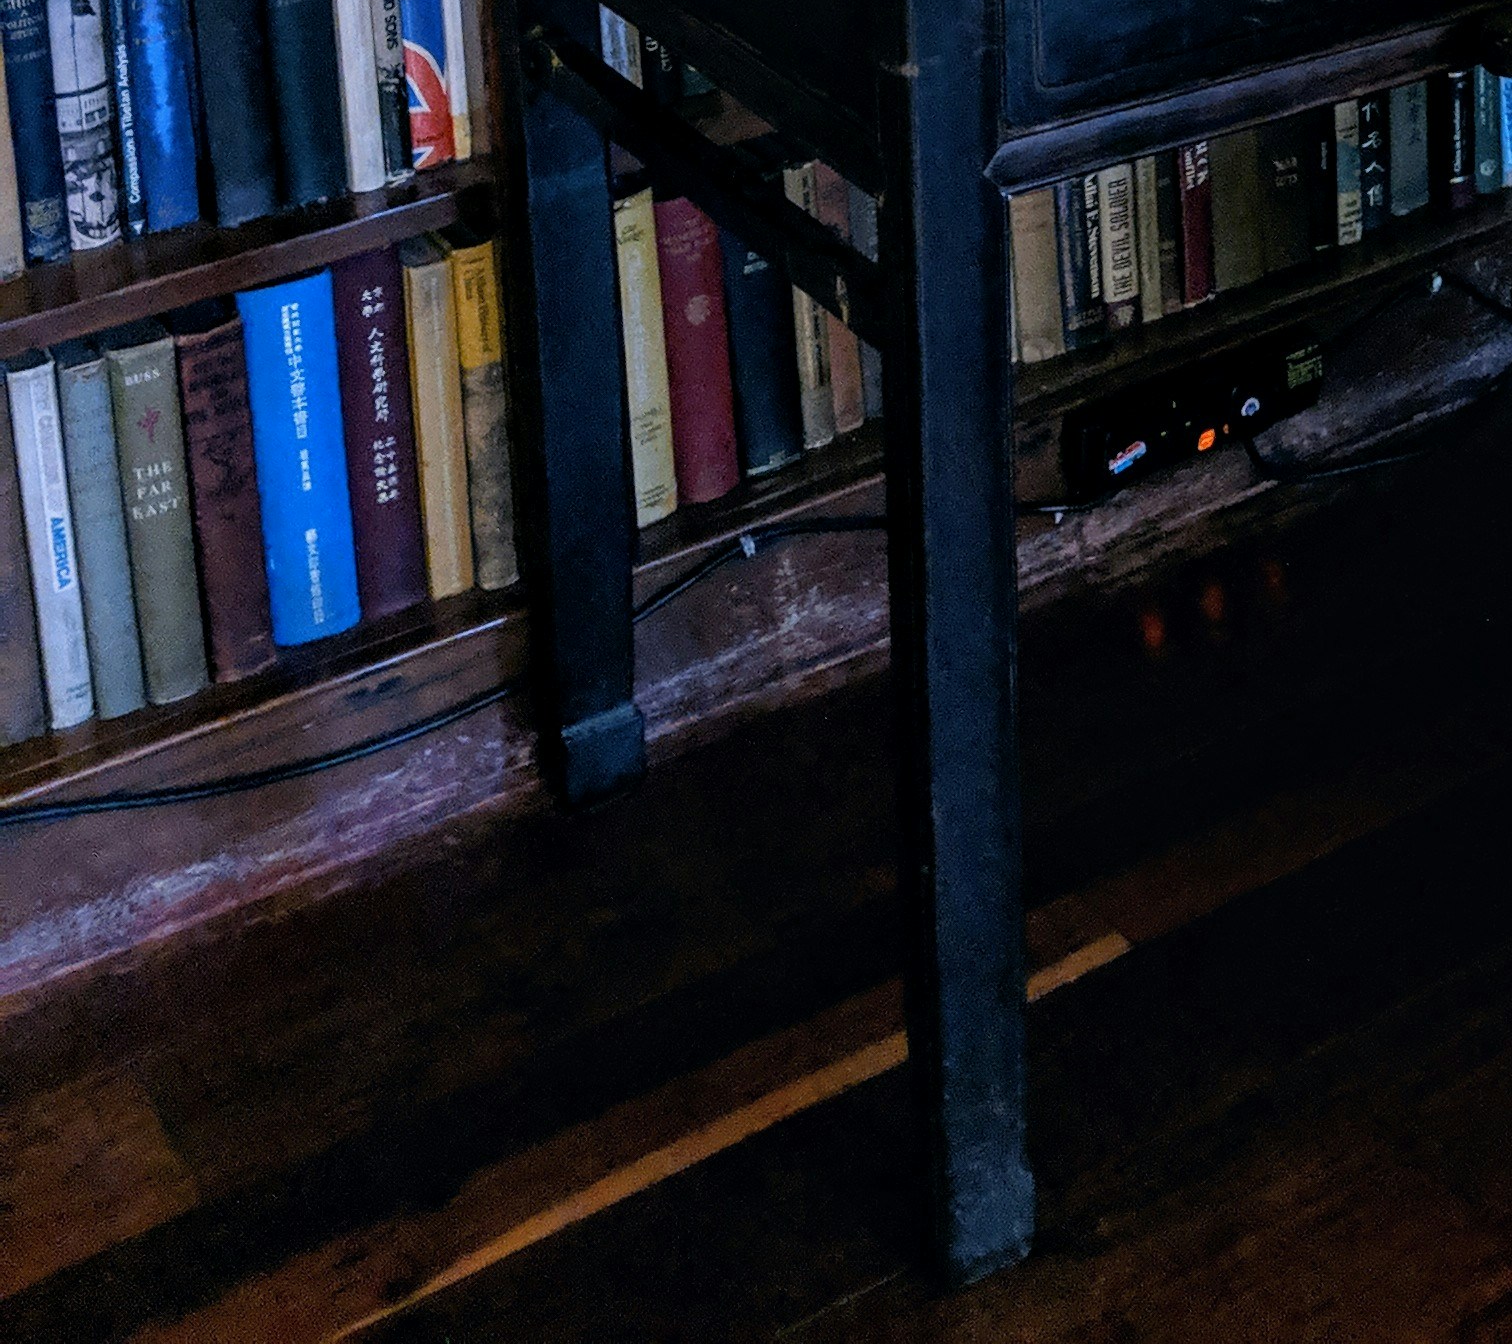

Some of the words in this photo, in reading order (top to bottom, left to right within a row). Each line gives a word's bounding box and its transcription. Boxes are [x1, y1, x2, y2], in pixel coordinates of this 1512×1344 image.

[385, 15, 399, 51] SONS
[116, 43, 130, 86] Analysis
[120, 88, 134, 126] Tibetan
[1108, 178, 1130, 232] SOLDIER
[1110, 232, 1132, 270] DEVIL
[1112, 270, 1133, 298] THE
[125, 369, 162, 386] BUSS
[133, 461, 173, 483] THE
[137, 480, 173, 500] FAR
[133, 495, 181, 522] EAST
[49, 516, 75, 590] AMERICA
